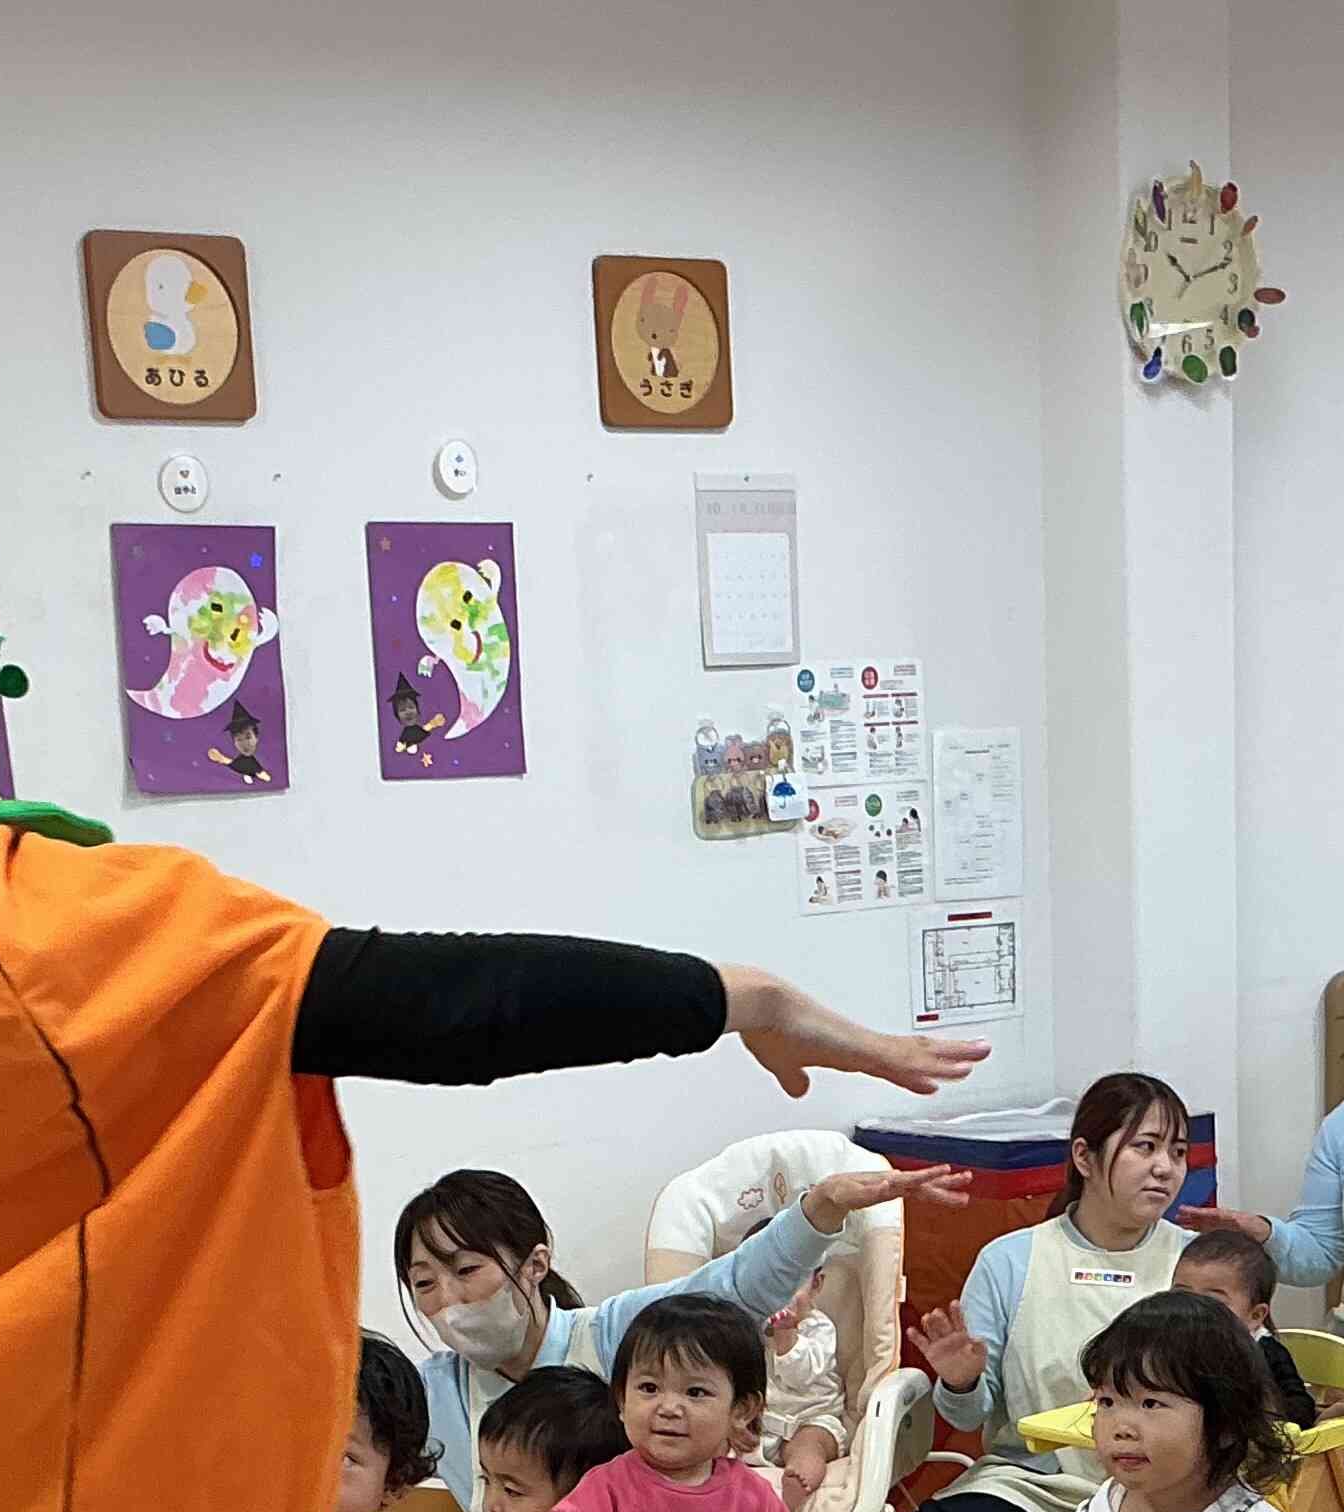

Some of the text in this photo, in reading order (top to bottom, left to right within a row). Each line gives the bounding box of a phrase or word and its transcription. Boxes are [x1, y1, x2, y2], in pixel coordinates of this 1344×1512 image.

[144, 367, 209, 388] あひる
[639, 378, 694, 399] うさぎ
